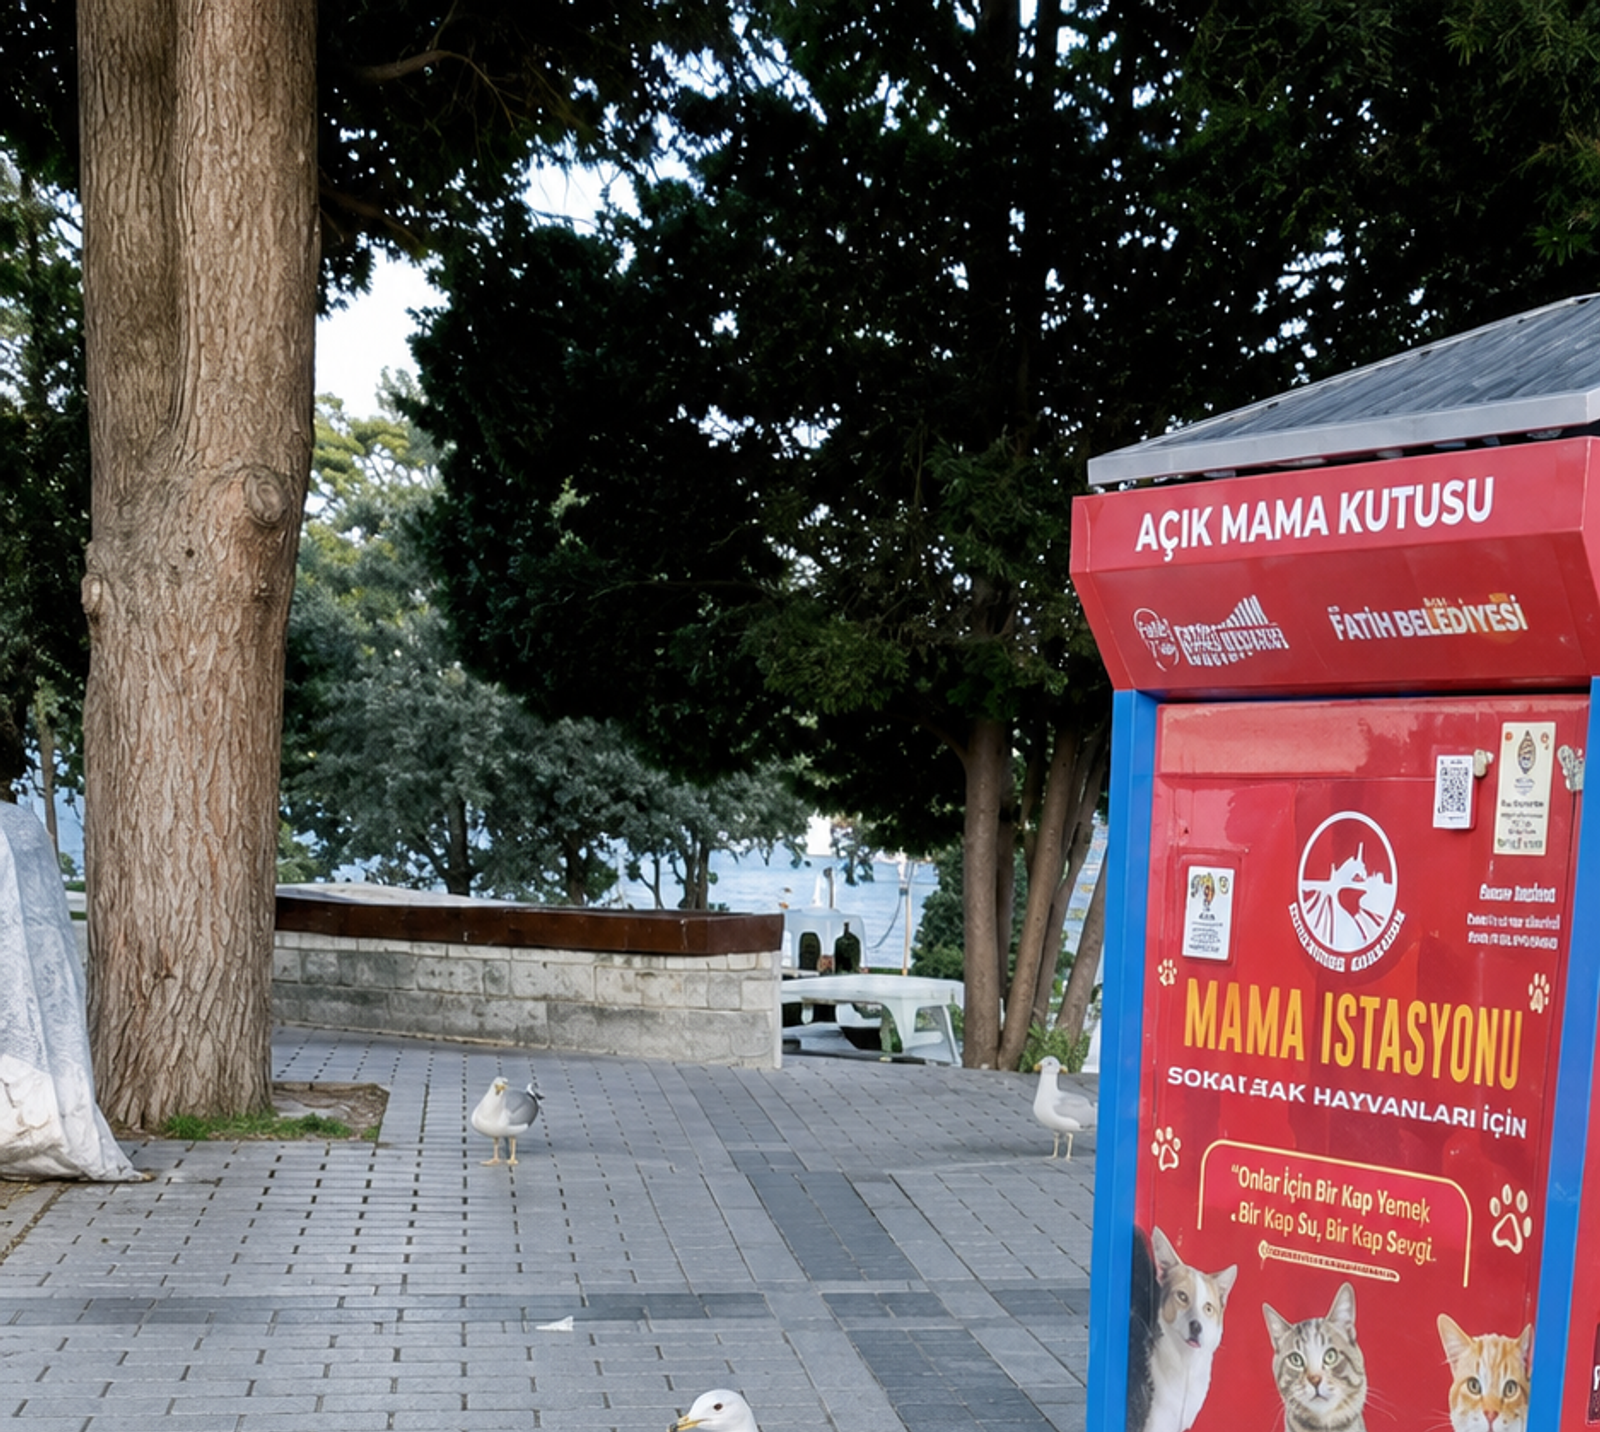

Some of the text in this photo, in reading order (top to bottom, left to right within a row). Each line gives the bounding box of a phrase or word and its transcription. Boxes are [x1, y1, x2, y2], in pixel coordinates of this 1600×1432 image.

[1135, 476, 1494, 562] AÇIK MAMA KUTUSU
[1392, 594, 1528, 637] BELEDİYESİ
[1184, 978, 1523, 1090] MAMA ISTASYONU
[1313, 1086, 1476, 1128] HAYVANLARI
[1315, 1179, 1338, 1204] Bir
[1341, 1184, 1373, 1216] Kap
[1377, 1189, 1430, 1228] Yemek
[1264, 1206, 1293, 1237] Kap
[1298, 1212, 1321, 1243] Su,
[1326, 1218, 1349, 1243] Bir
[1352, 1223, 1382, 1255] Kap
